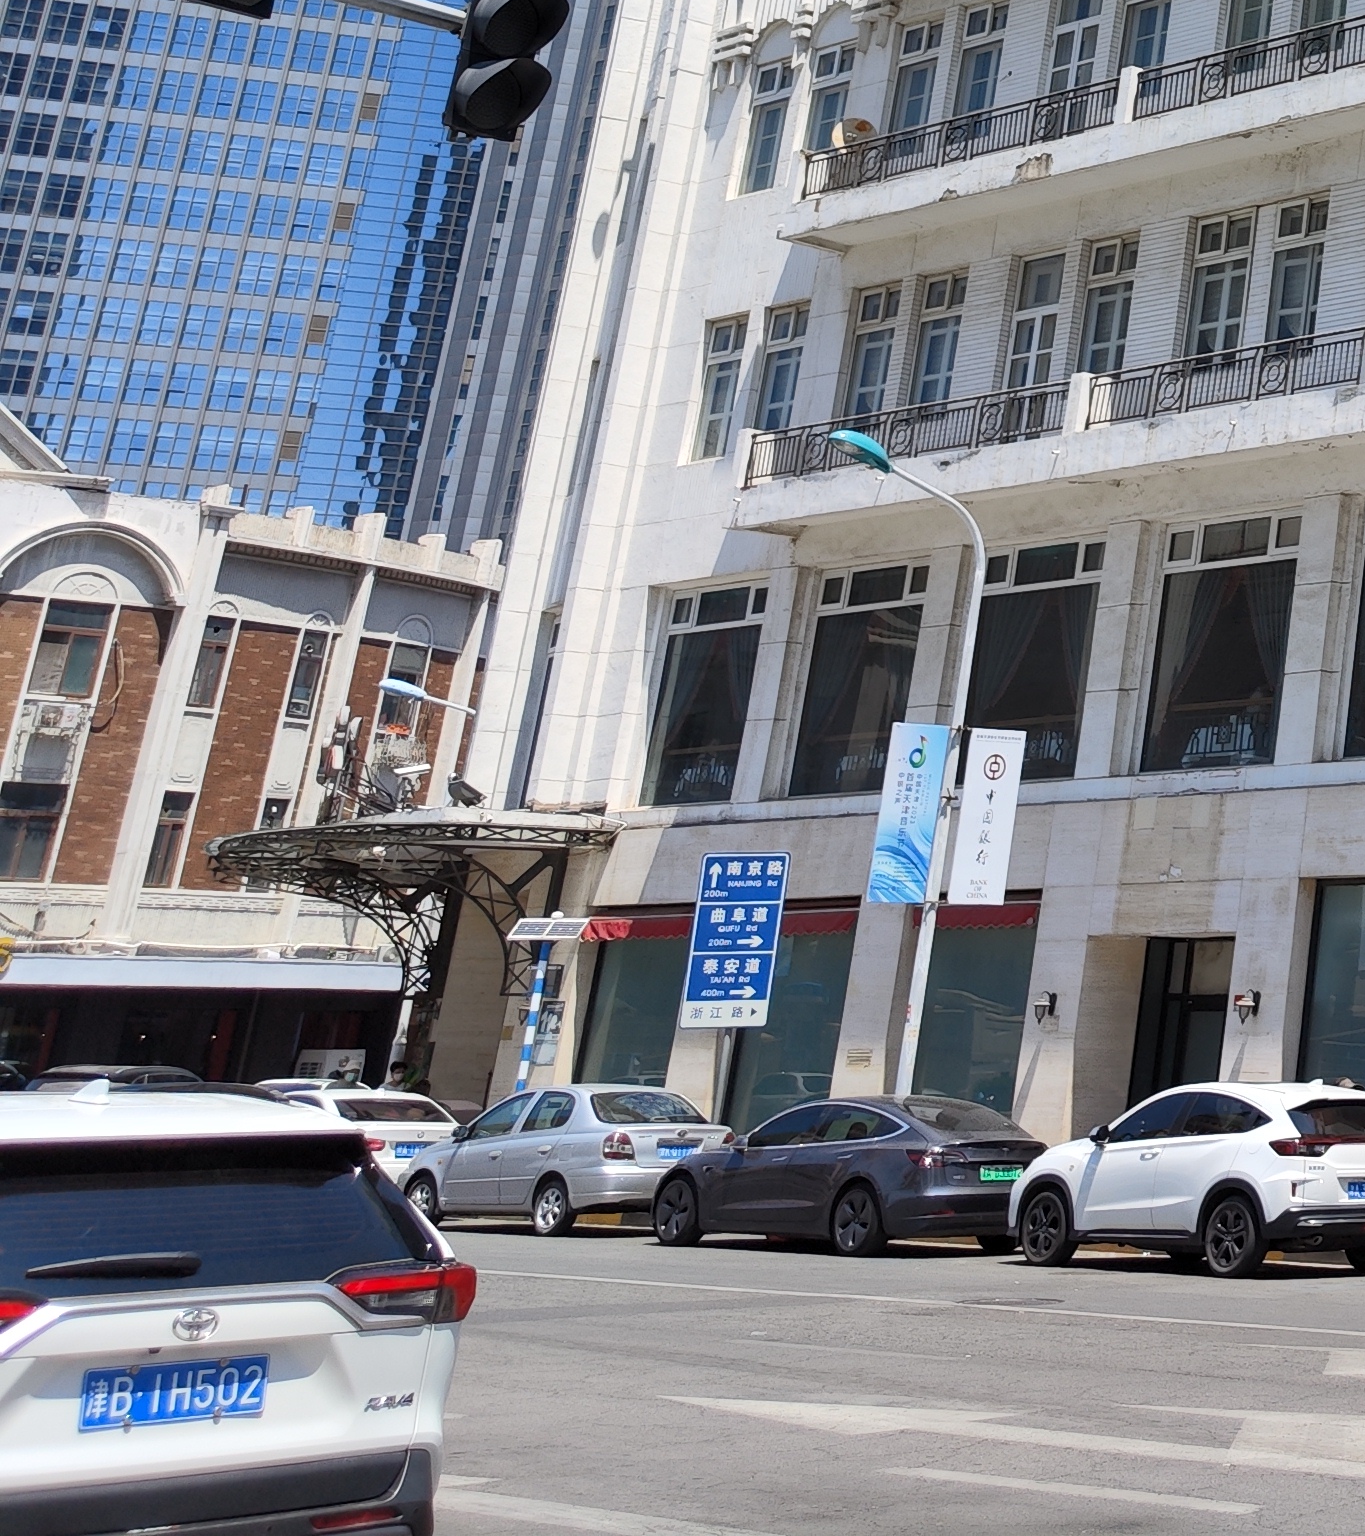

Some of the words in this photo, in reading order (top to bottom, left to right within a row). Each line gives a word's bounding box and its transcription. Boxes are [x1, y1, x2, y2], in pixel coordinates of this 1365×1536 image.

[726, 860, 784, 876] 南京路
[727, 880, 762, 888] NANJING
[703, 889, 729, 898] 200m
[710, 907, 769, 924] 曲阜道
[717, 925, 741, 933] QUFU
[708, 938, 732, 947] 200m
[702, 958, 762, 975] 泰安道
[700, 989, 725, 998] 400m
[690, 1006, 744, 1020] 浙江路
[364, 1392, 416, 1412] RAV4
